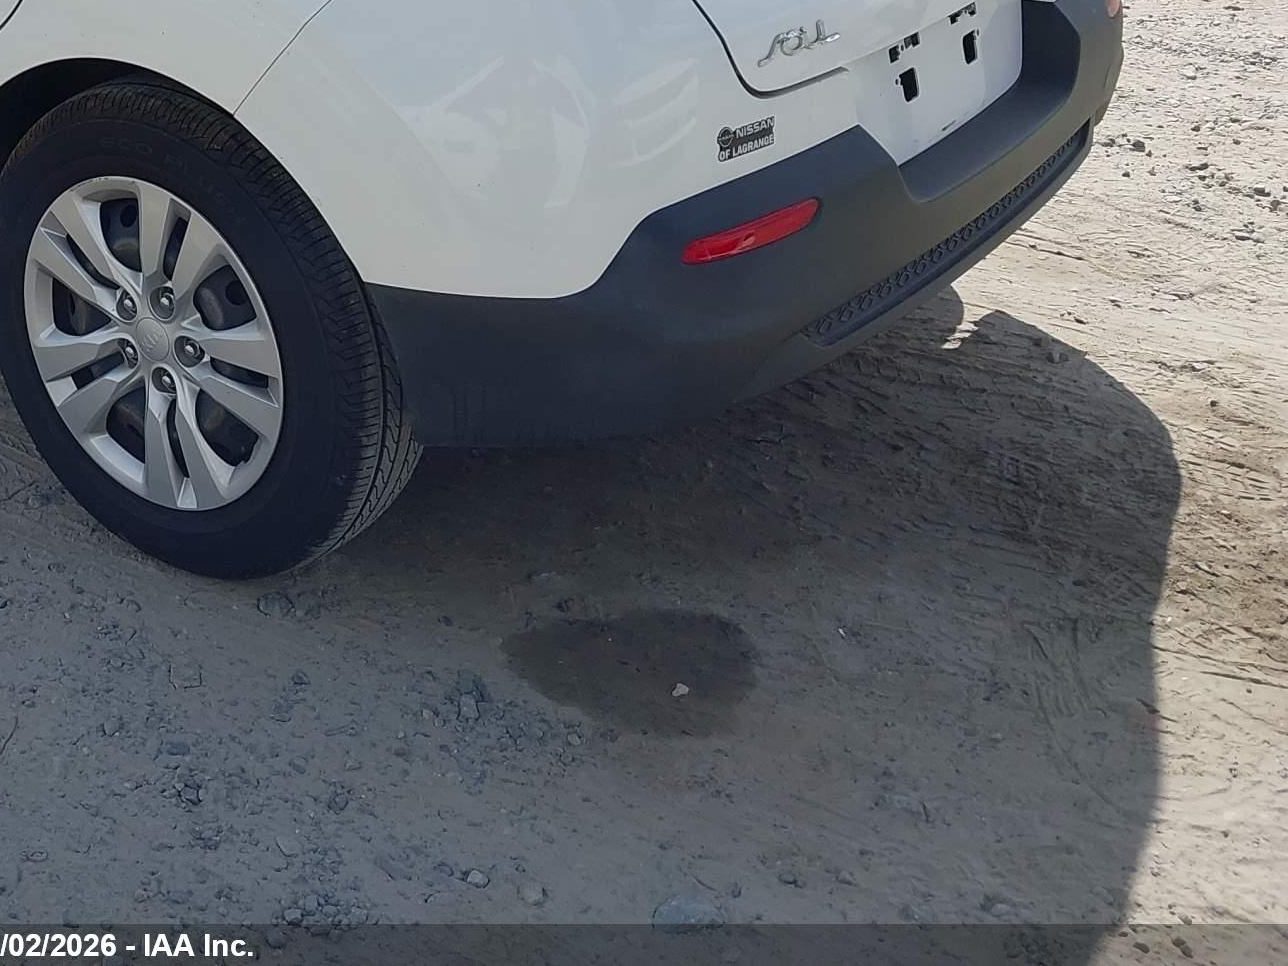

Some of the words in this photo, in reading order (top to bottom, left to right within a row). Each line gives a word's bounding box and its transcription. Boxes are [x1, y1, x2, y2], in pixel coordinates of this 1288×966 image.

[757, 18, 841, 68] SOUL
[735, 118, 775, 139] NISSAN
[719, 148, 731, 161] OF
[732, 134, 775, 157] LAGRANGE
